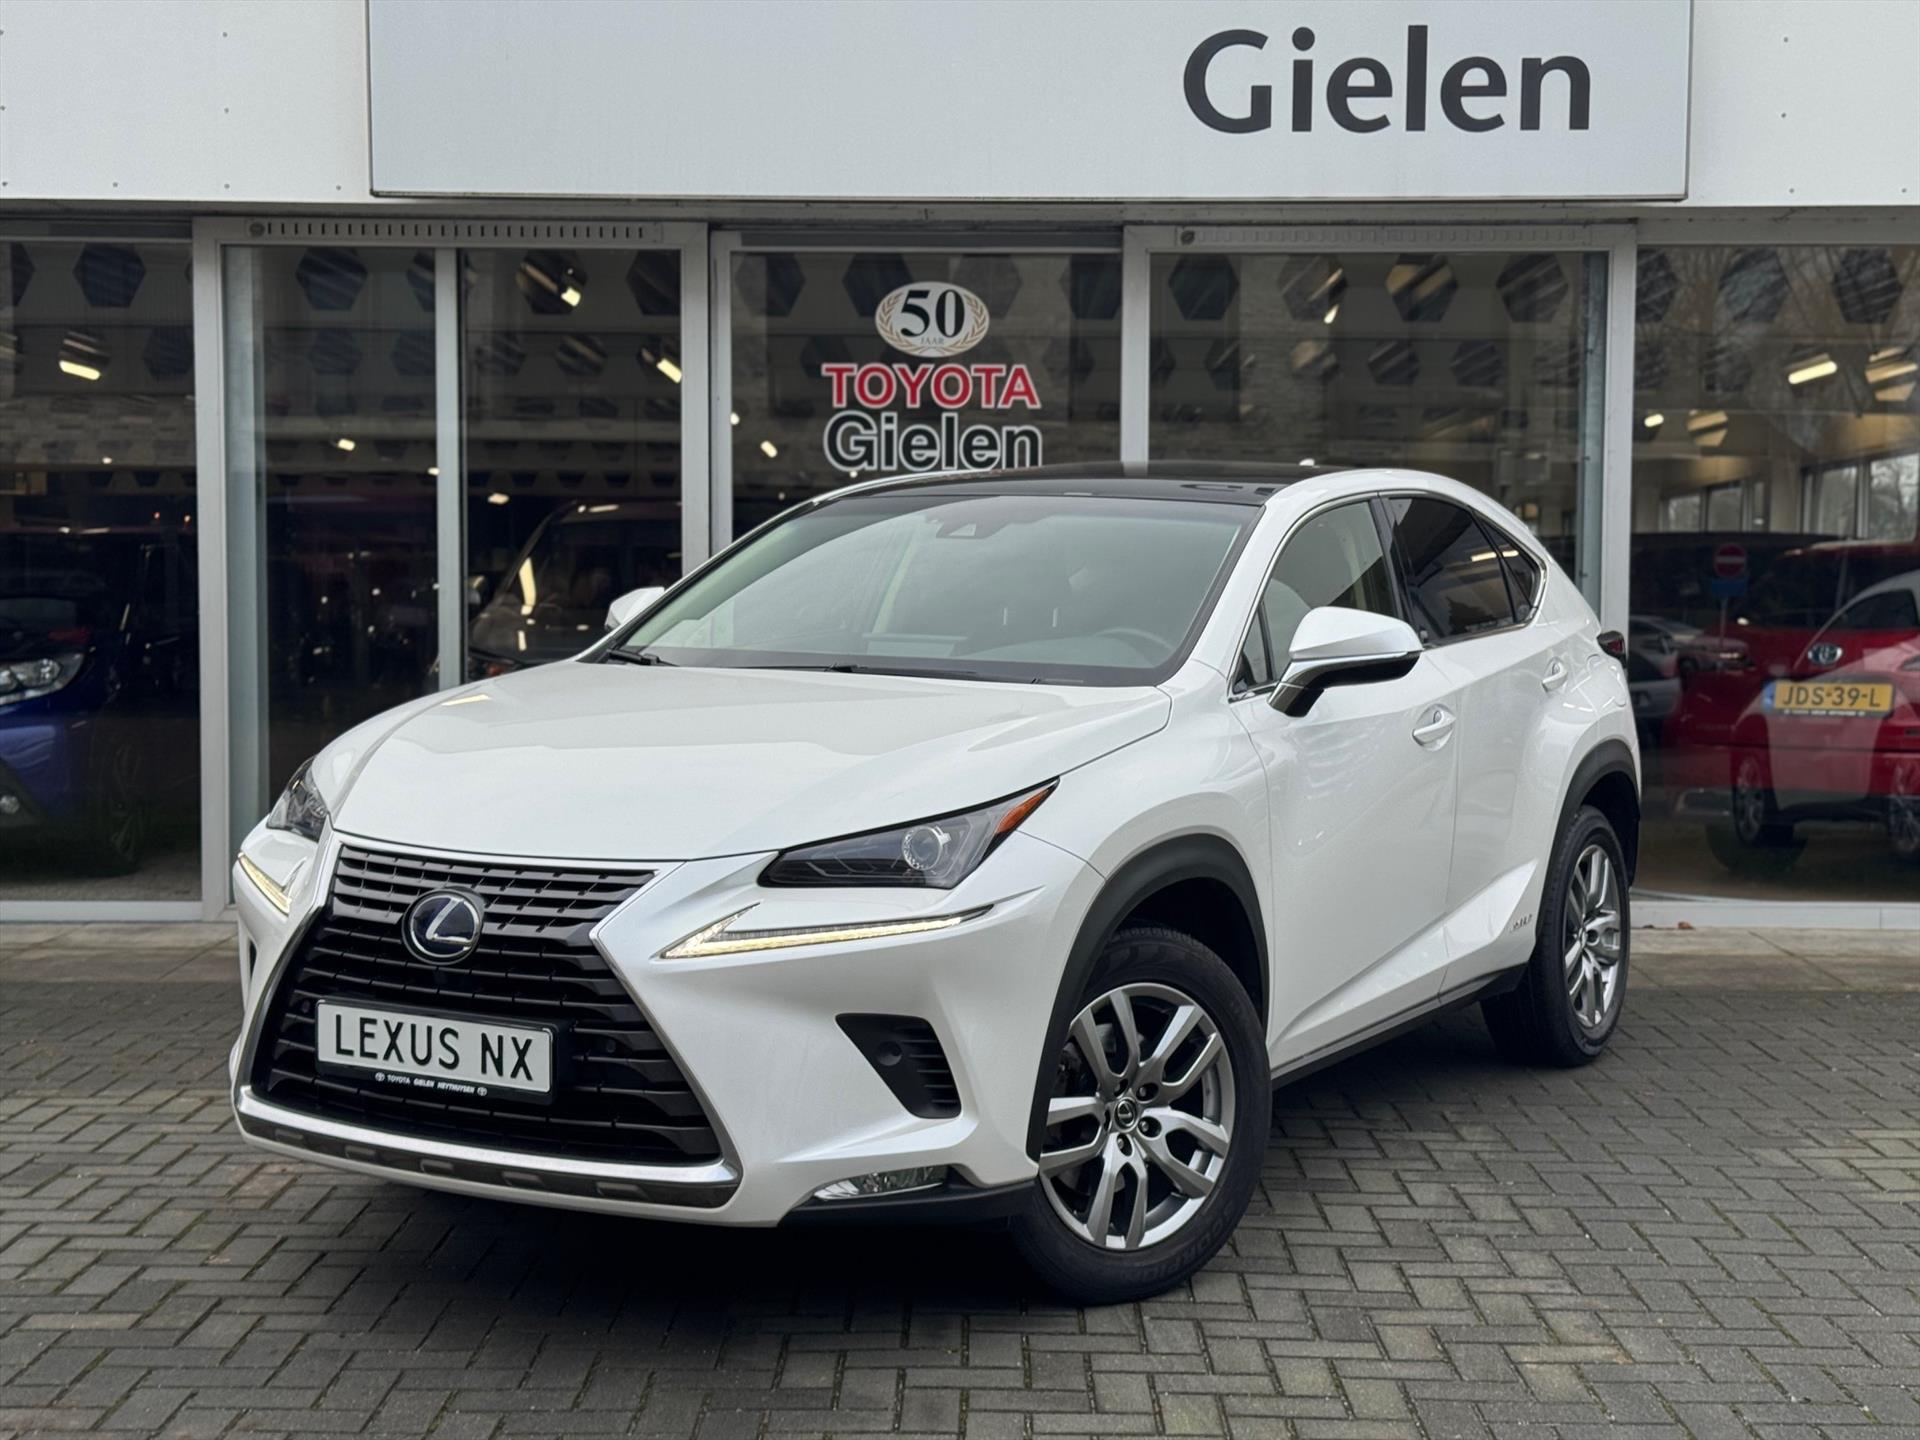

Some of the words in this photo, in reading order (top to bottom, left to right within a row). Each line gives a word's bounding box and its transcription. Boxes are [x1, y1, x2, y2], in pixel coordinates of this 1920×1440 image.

[1183, 24, 1591, 134] Gielen
[900, 288, 965, 338] 50
[821, 363, 1042, 409] TOYOTA
[823, 410, 1043, 471] Gielen
[1782, 685, 1881, 708] JDS-39-L
[335, 1013, 460, 1070] LEXUS
[480, 1031, 534, 1082] NX
[387, 1074, 411, 1085] TOYOTA
